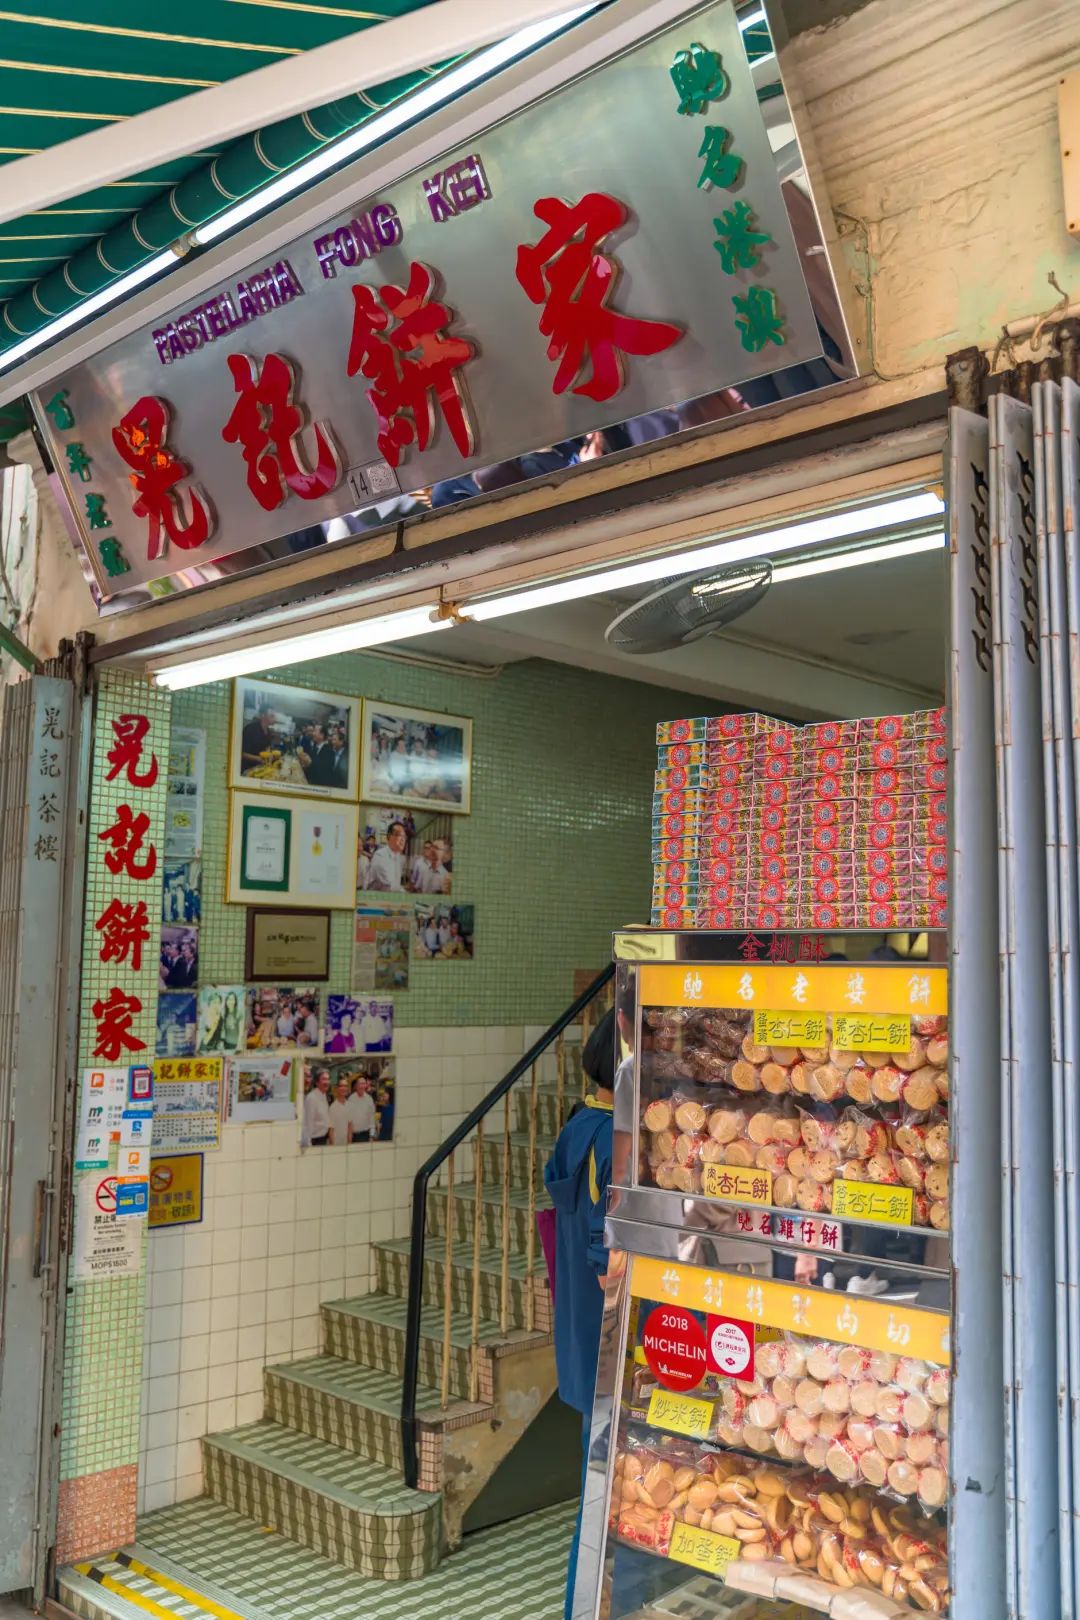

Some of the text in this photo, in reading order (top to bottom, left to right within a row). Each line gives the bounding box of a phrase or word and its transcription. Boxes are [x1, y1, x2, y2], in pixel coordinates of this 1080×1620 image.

[152, 154, 492, 365] PASTELARIA FONG KEI
[112, 192, 686, 562] 晃記餅家
[351, 472, 368, 499] 14
[92, 713, 159, 1061] 晃記餅家
[737, 931, 830, 964] 金桃酥
[683, 971, 932, 1005] 馳名老婆餅
[768, 1017, 823, 1041] 杏仁餅
[849, 1021, 909, 1045] 杏仁餅
[717, 1172, 768, 1200] 杏仁餅
[848, 1190, 909, 1219] 杏仁餅
[738, 1212, 839, 1250] 馳名雞仔餅
[661, 1314, 689, 1331] 2018
[644, 1334, 707, 1362] MICHELIN
[652, 1397, 708, 1431] 炒米餅
[674, 1531, 734, 1568] 加蛋餅
